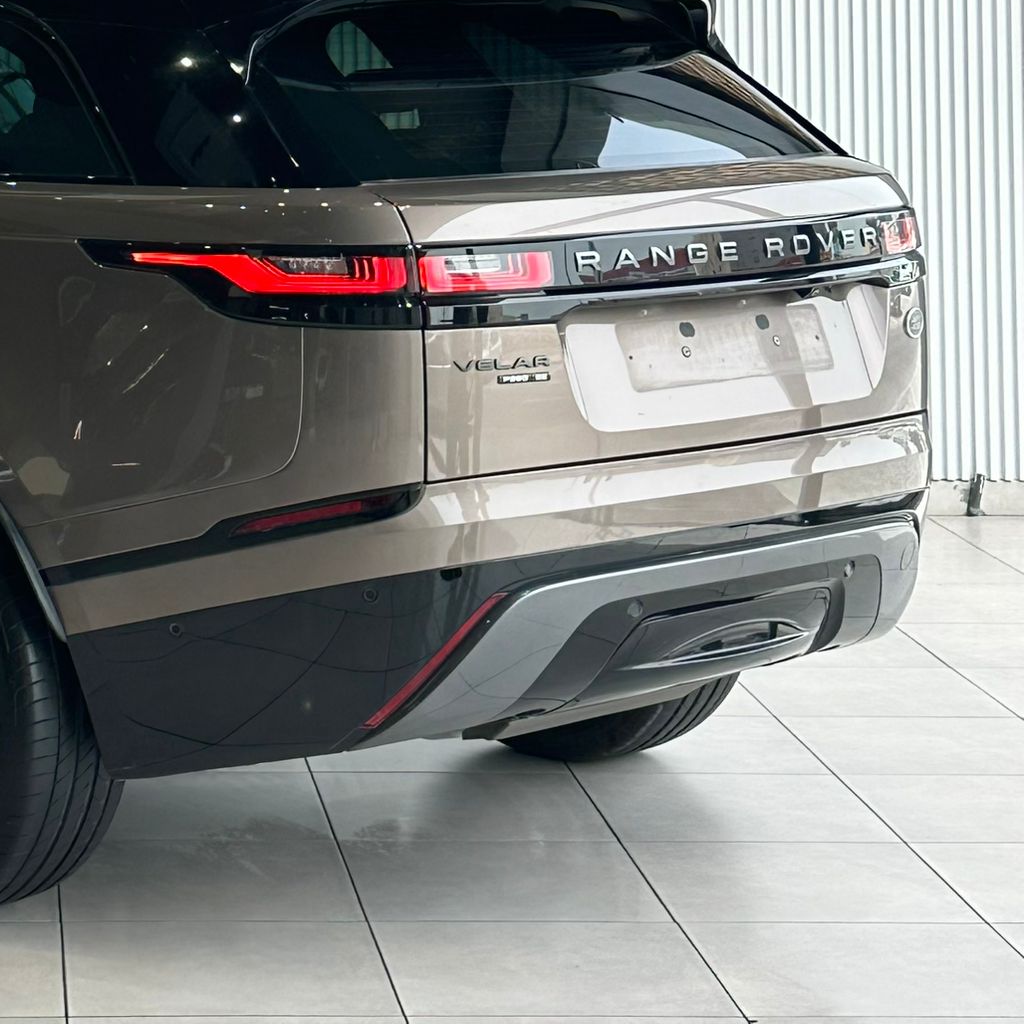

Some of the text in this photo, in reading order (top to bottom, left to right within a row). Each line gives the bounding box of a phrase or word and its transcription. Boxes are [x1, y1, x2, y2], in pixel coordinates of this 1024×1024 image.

[575, 226, 878, 272] RANGE ROVER
[453, 355, 550, 372] VELAR
